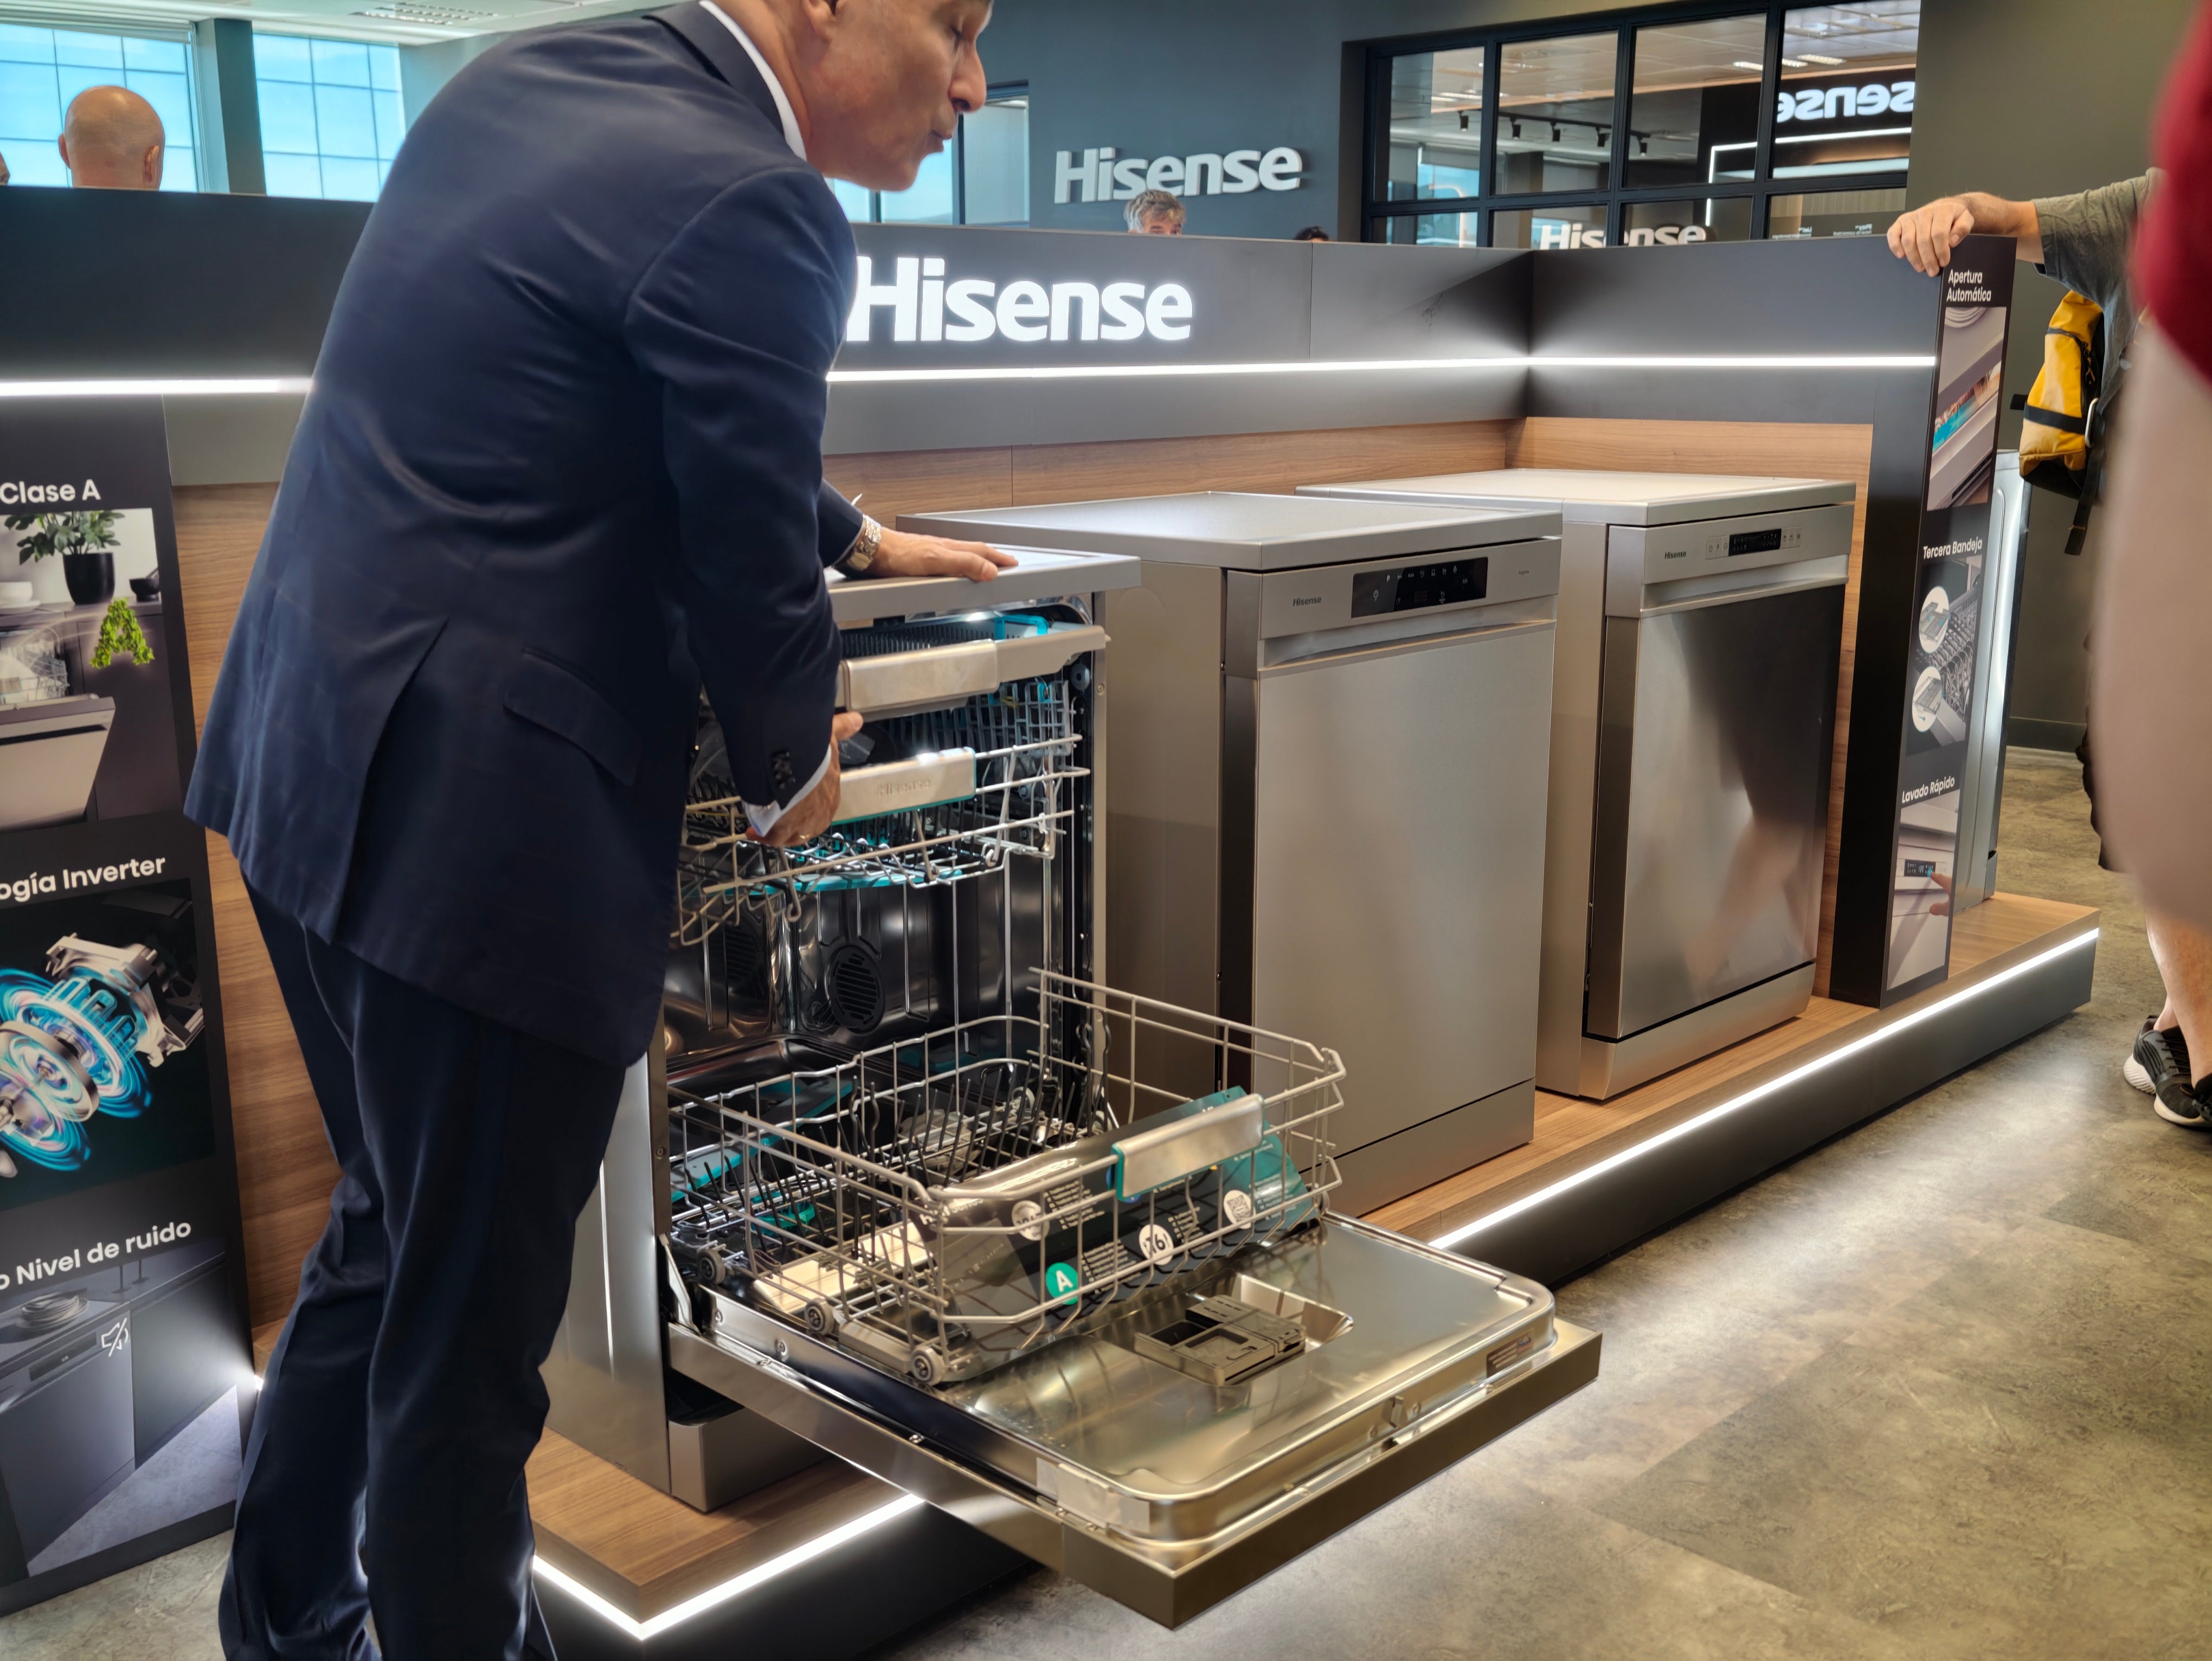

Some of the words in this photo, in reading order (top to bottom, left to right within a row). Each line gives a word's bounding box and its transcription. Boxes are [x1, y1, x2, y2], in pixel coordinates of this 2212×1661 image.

[1054, 147, 1302, 204] Hisense
[1948, 268, 1983, 288] Apertura
[846, 255, 1193, 342] Hisense
[1946, 286, 1992, 302] Automática
[0, 481, 76, 505] Clase
[82, 479, 101, 501] A
[1664, 551, 1687, 560] Hisense
[1923, 545, 1951, 559] Tercera
[1952, 536, 1983, 554] Bandeja
[1293, 597, 1322, 607] Hisense
[1902, 784, 1929, 804] Lavado
[1930, 775, 1955, 795] Rápido
[63, 857, 166, 890] Inverter
[16, 1249, 81, 1285] Nivel
[87, 1242, 119, 1263] de
[126, 1222, 191, 1253] ruido
[1056, 1270, 1074, 1292] A
